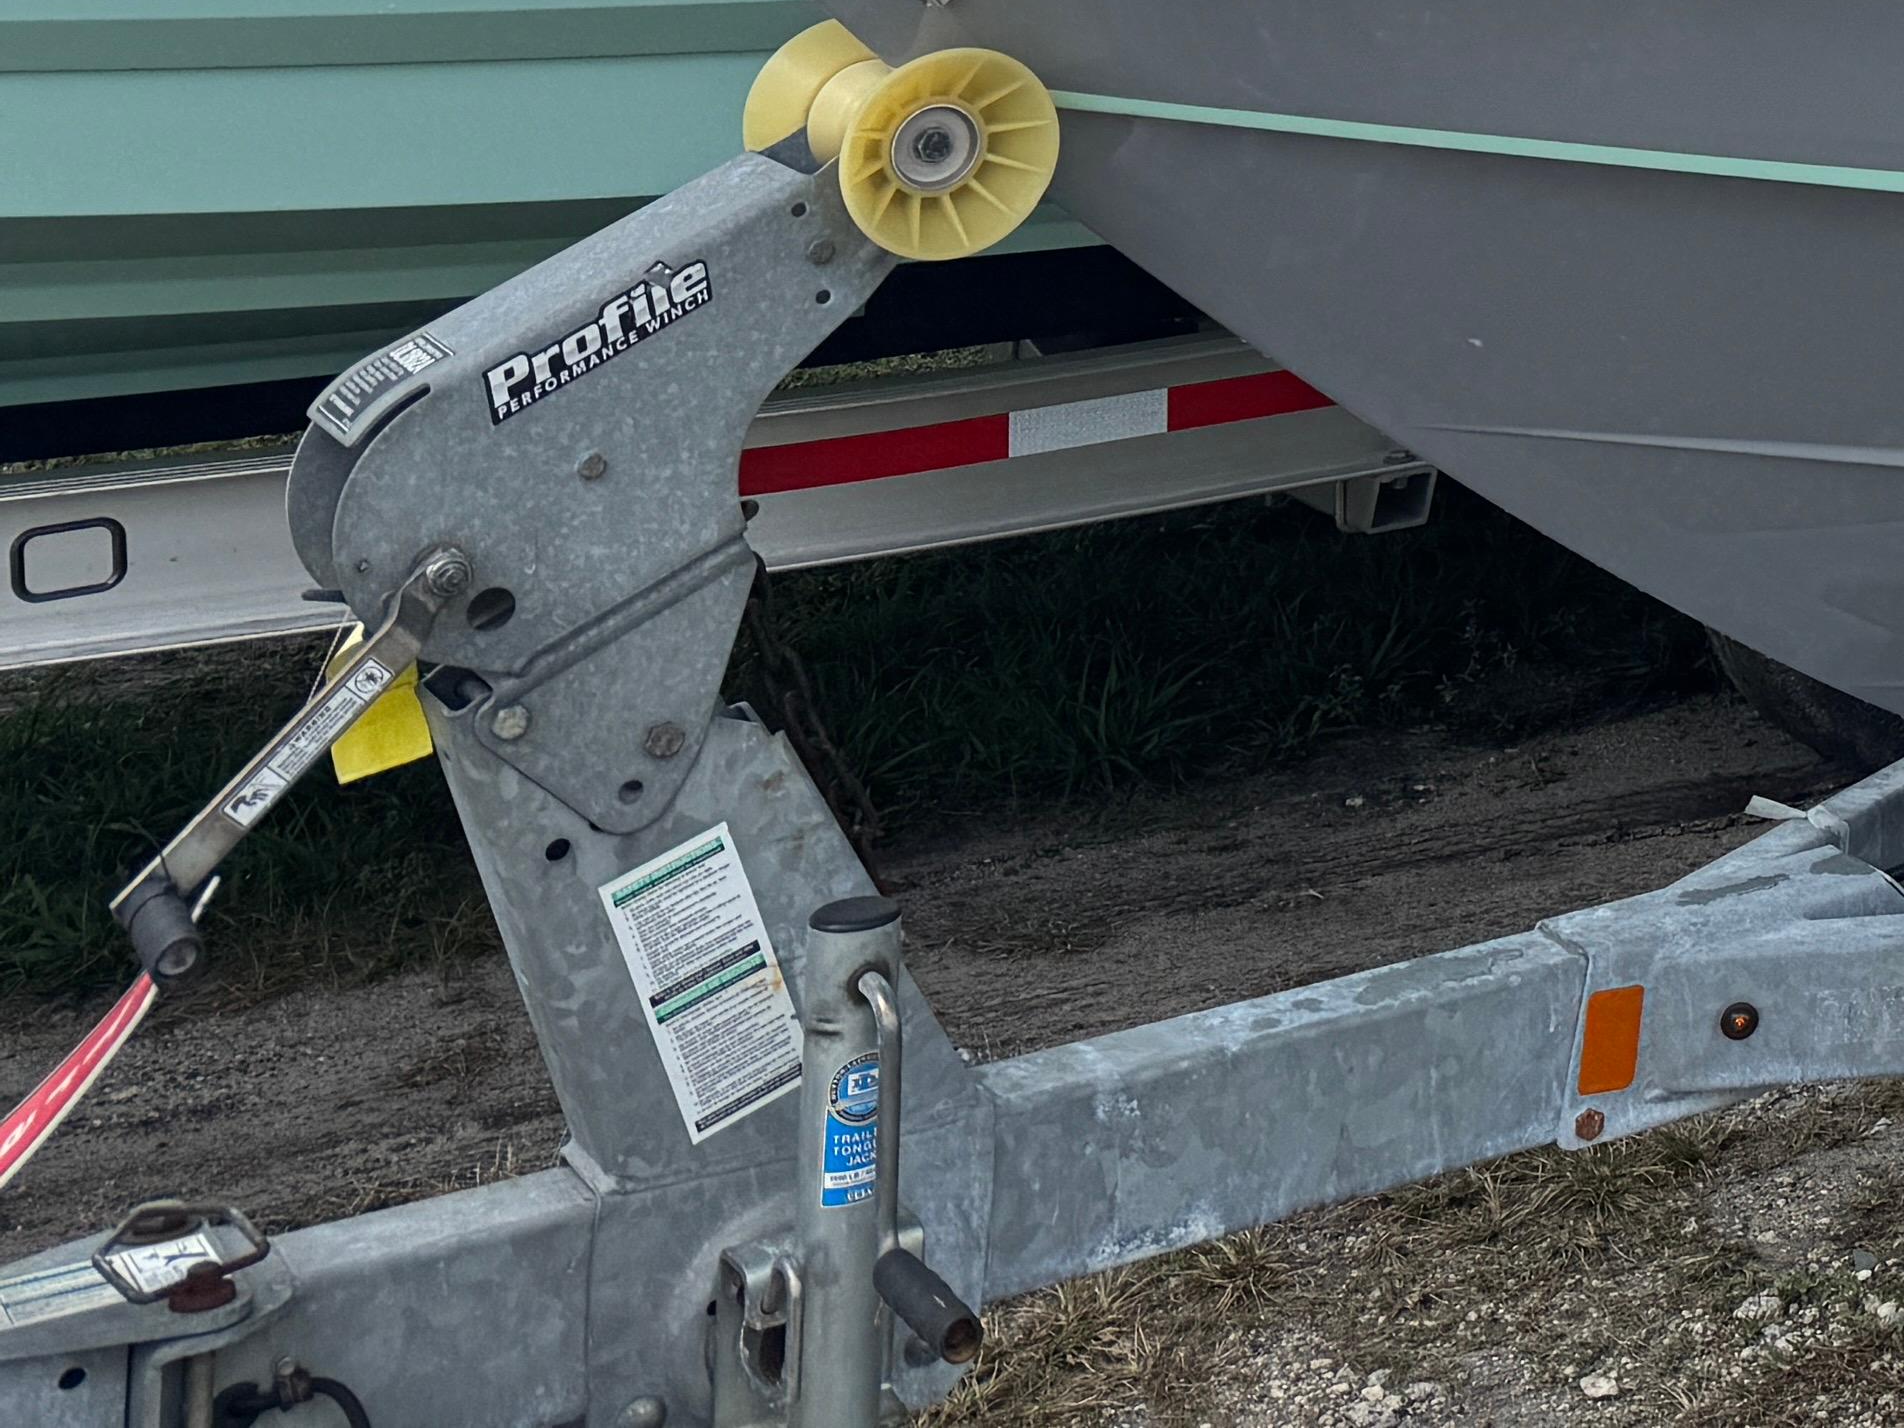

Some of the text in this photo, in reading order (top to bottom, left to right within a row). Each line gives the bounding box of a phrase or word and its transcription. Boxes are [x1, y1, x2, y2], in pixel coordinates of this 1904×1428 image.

[487, 261, 708, 409] Profile
[498, 330, 640, 420] PERFORMANCE
[645, 288, 709, 334] WINCH
